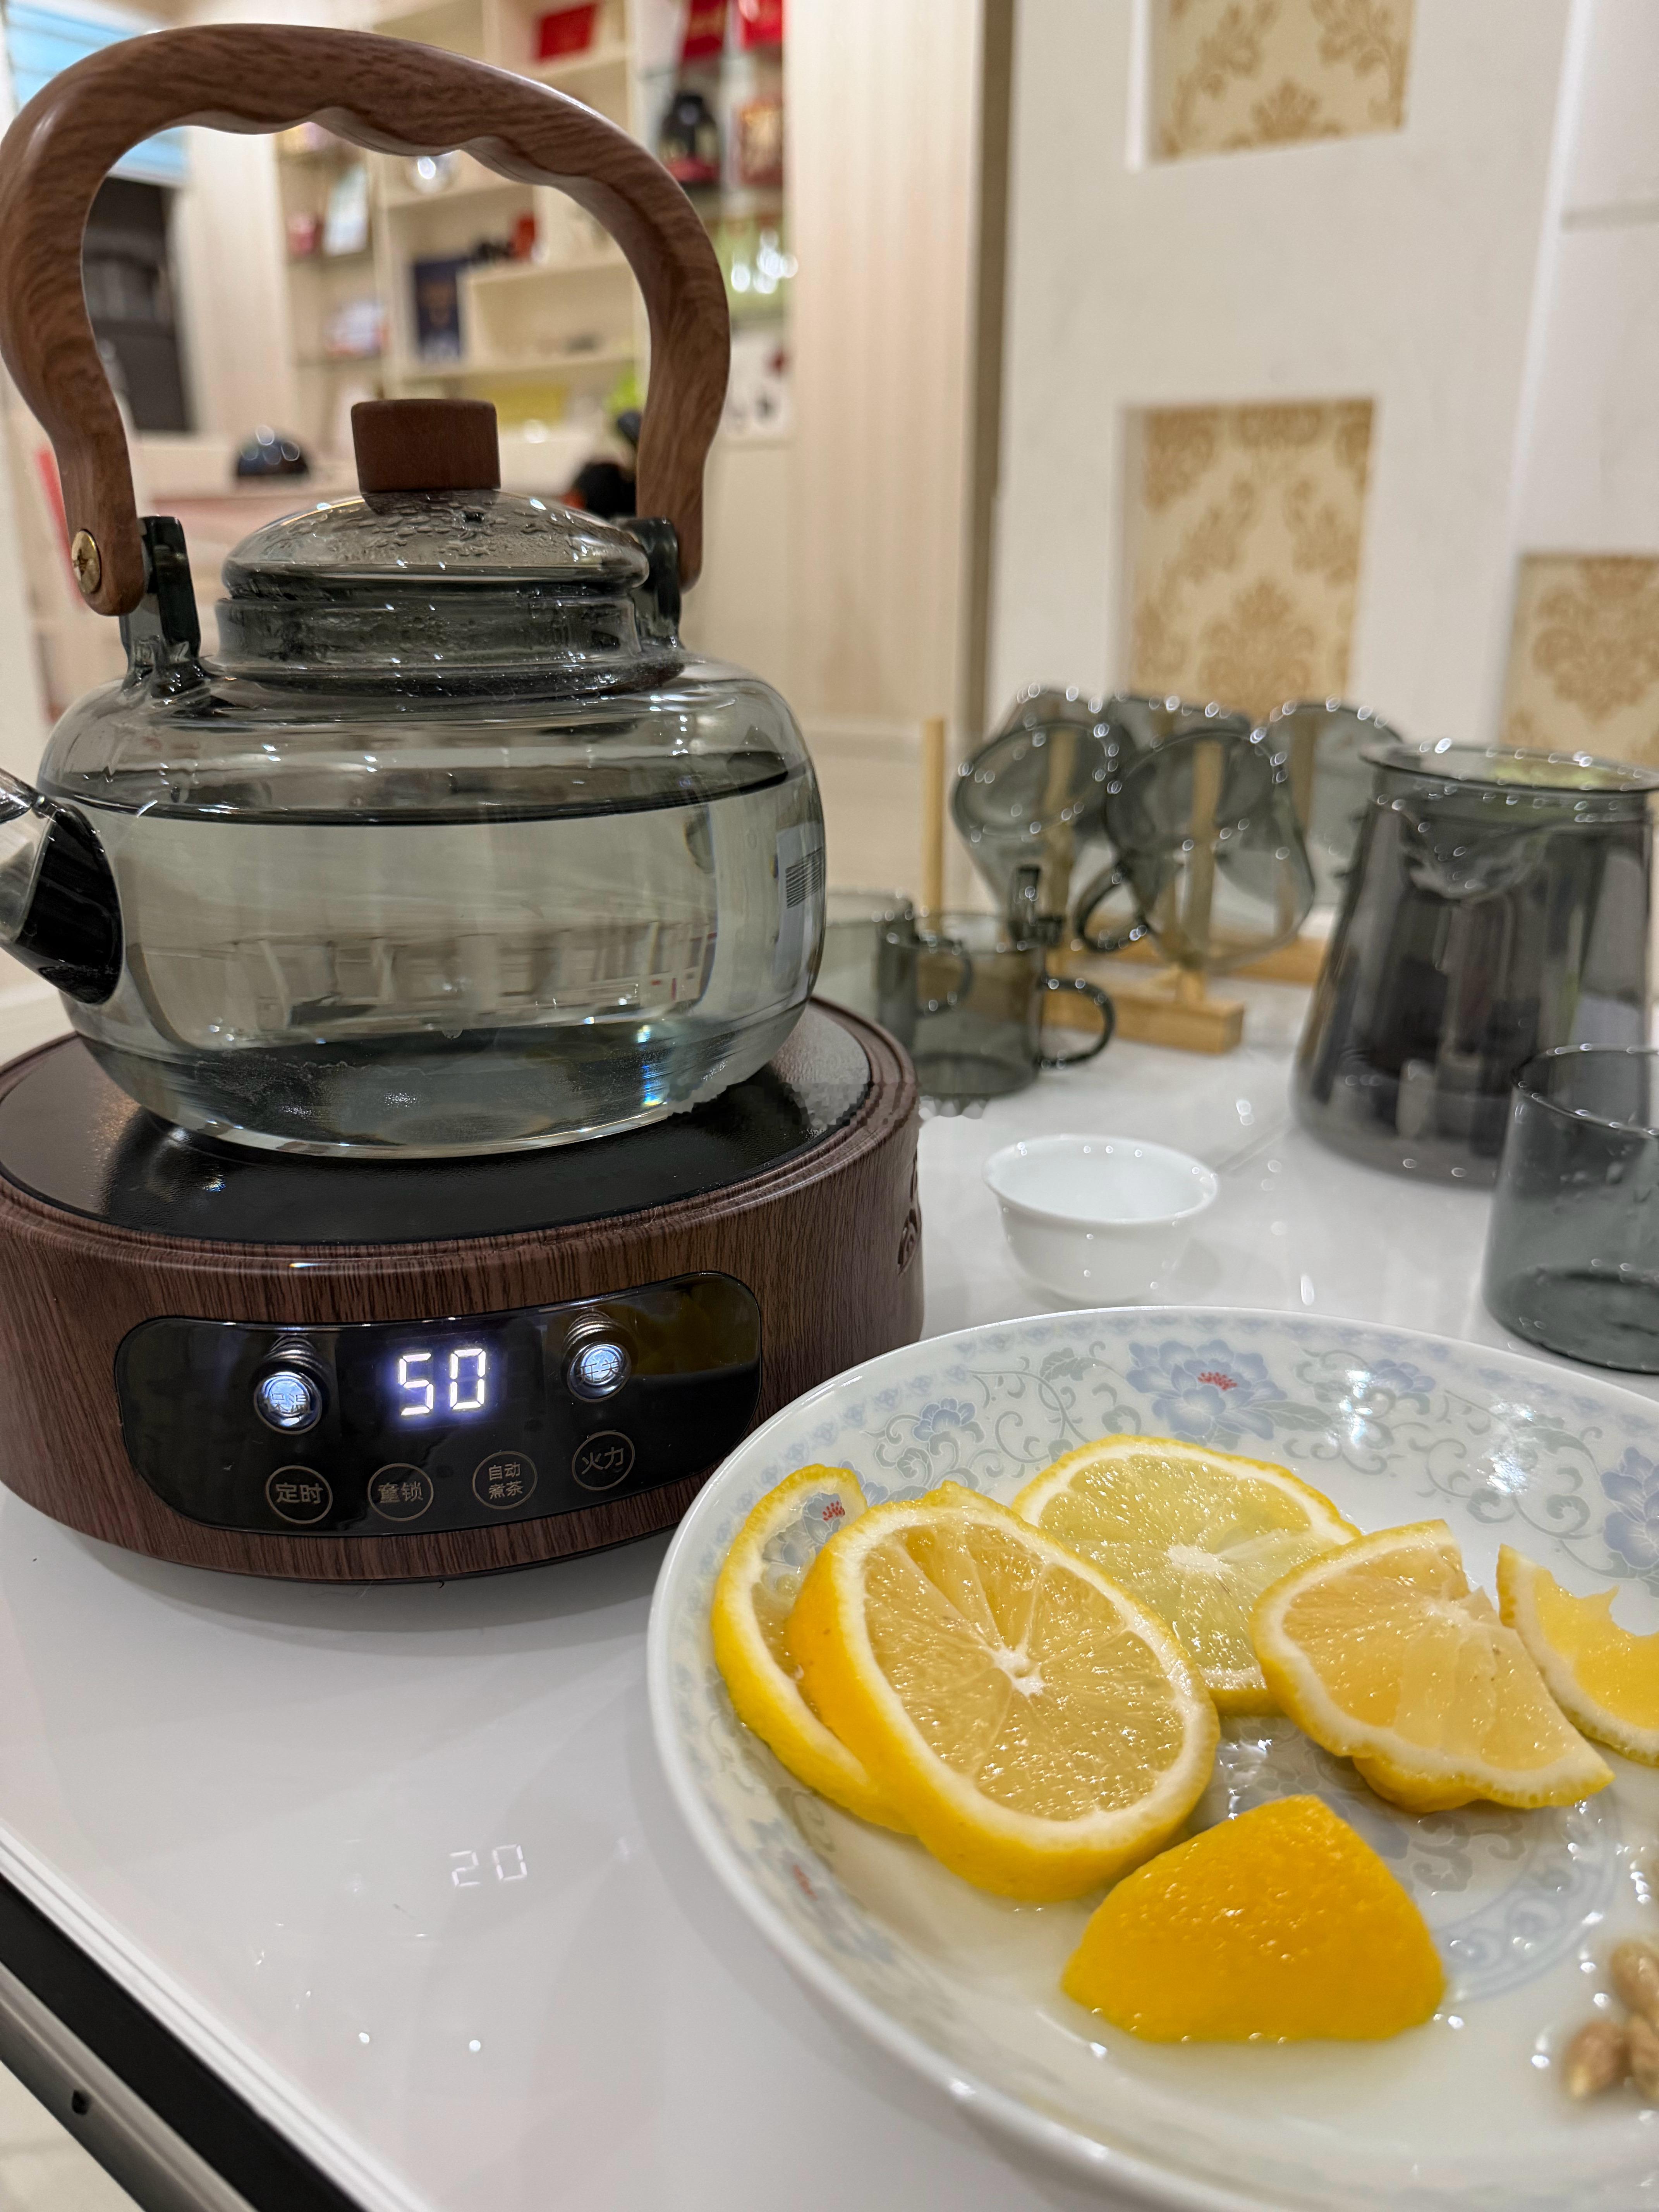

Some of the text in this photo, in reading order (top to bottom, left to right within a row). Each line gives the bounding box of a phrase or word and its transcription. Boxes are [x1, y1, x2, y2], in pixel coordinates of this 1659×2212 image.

[576, 1356, 621, 1384] 开关
[398, 1348, 486, 1416] 50
[263, 1392, 311, 1413] 保温
[488, 1462, 521, 1481] 自动
[581, 1446, 624, 1475] 火力
[276, 1482, 324, 1504] 定时
[378, 1481, 424, 1503] 童锁
[488, 1480, 524, 1500] 煮茶
